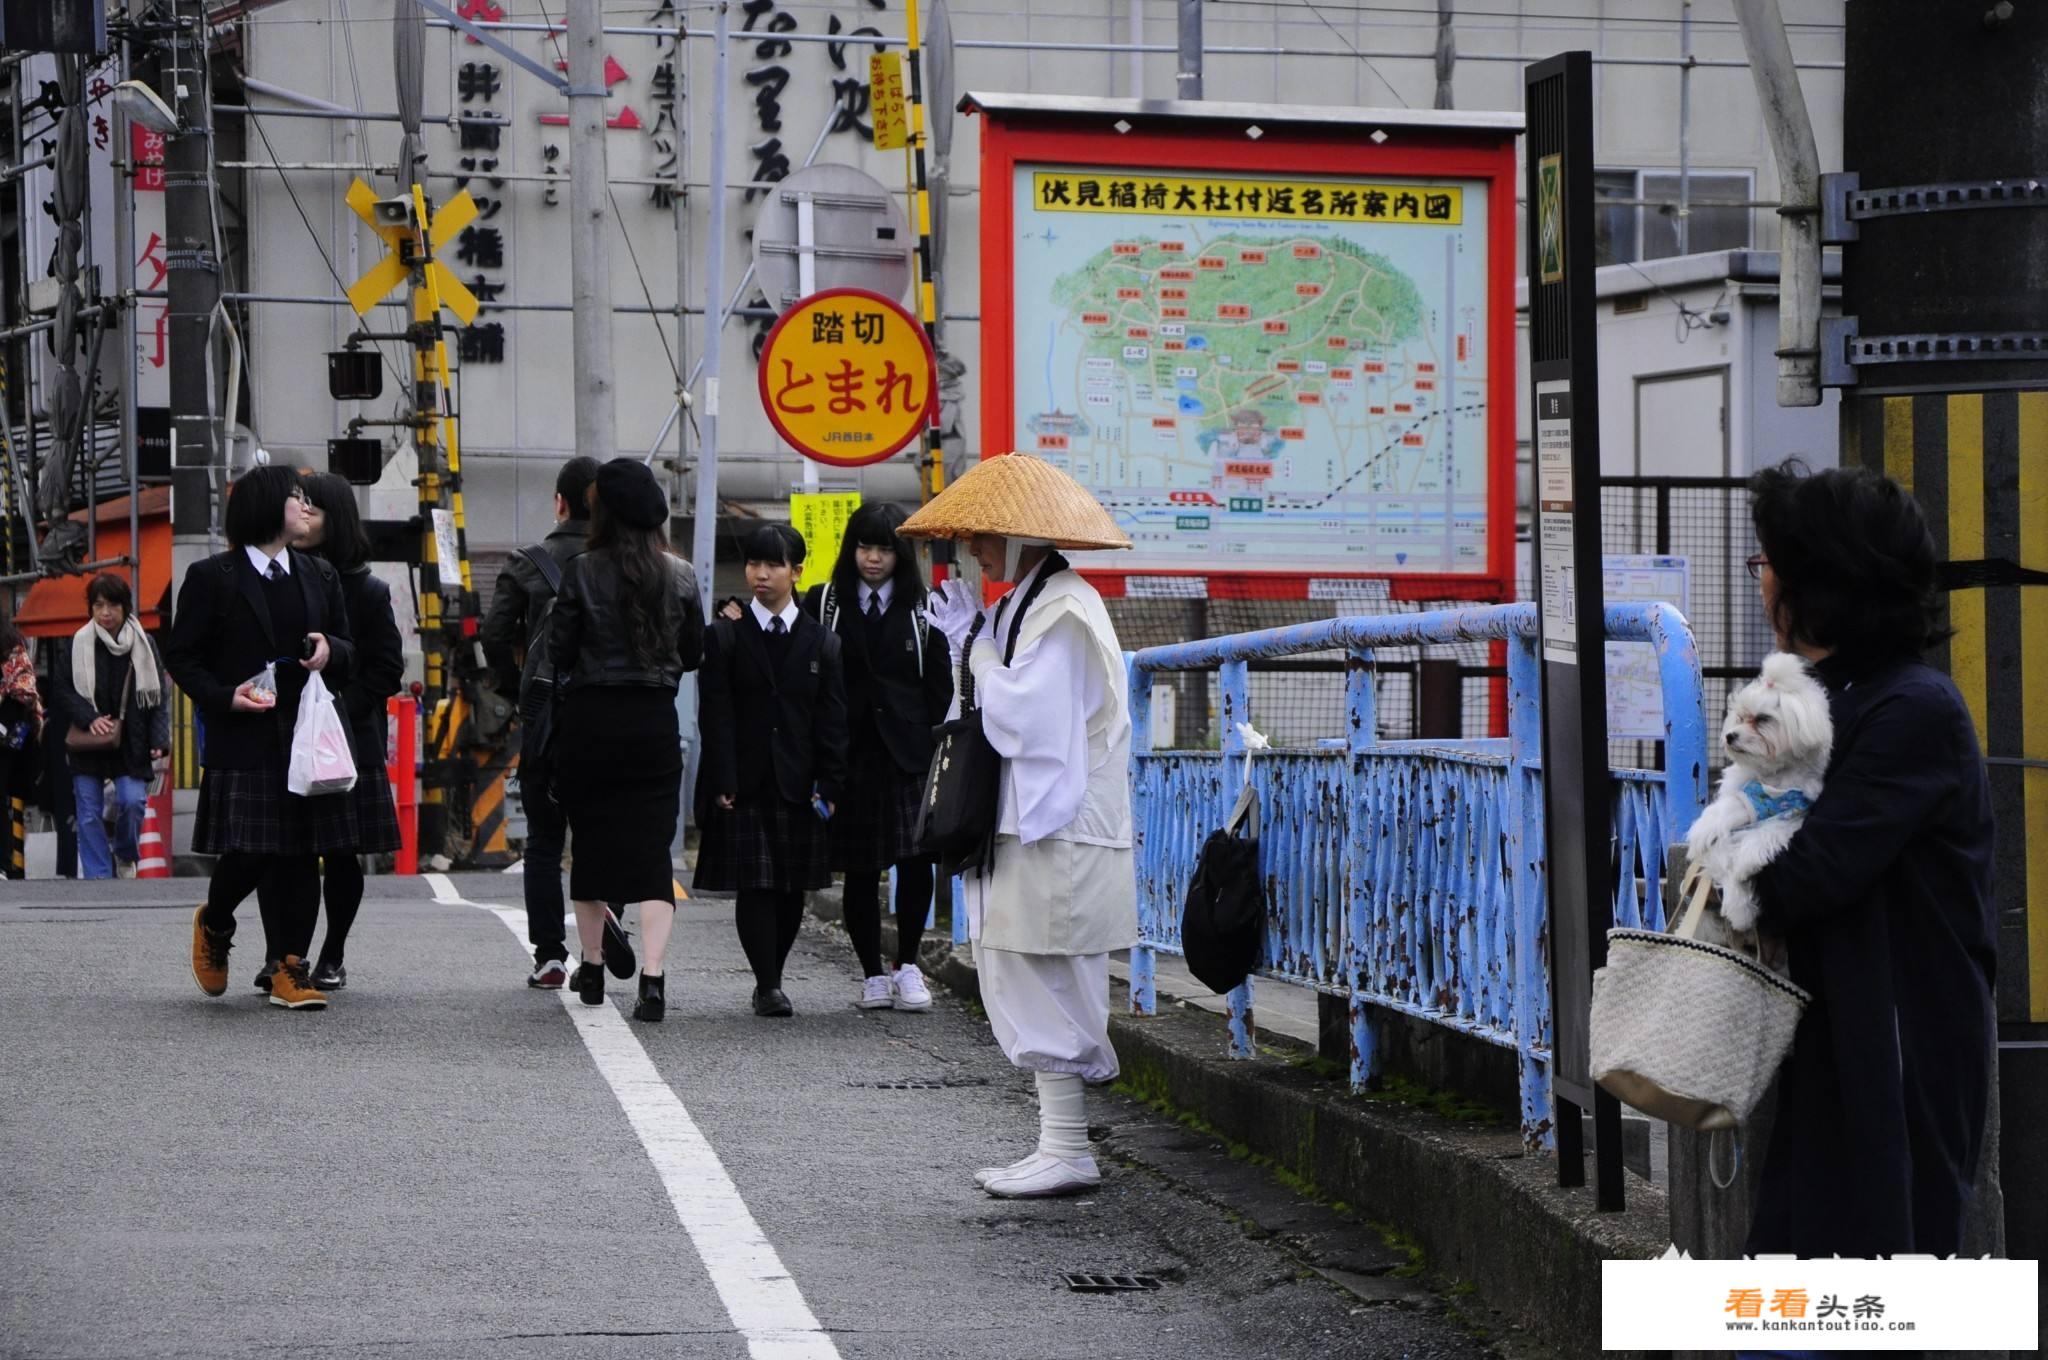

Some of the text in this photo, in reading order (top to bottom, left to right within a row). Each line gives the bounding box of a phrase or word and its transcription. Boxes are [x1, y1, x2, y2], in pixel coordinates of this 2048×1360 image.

[871, 55, 889, 148] お待ち下さい
[888, 73, 905, 126] しばらく
[144, 126, 166, 187] みやげ
[1043, 179, 1452, 220] 伏見稲荷大社付近名所案内図
[812, 311, 885, 345] 踏切
[775, 358, 921, 415] とまれ
[822, 431, 875, 442] JR西日本
